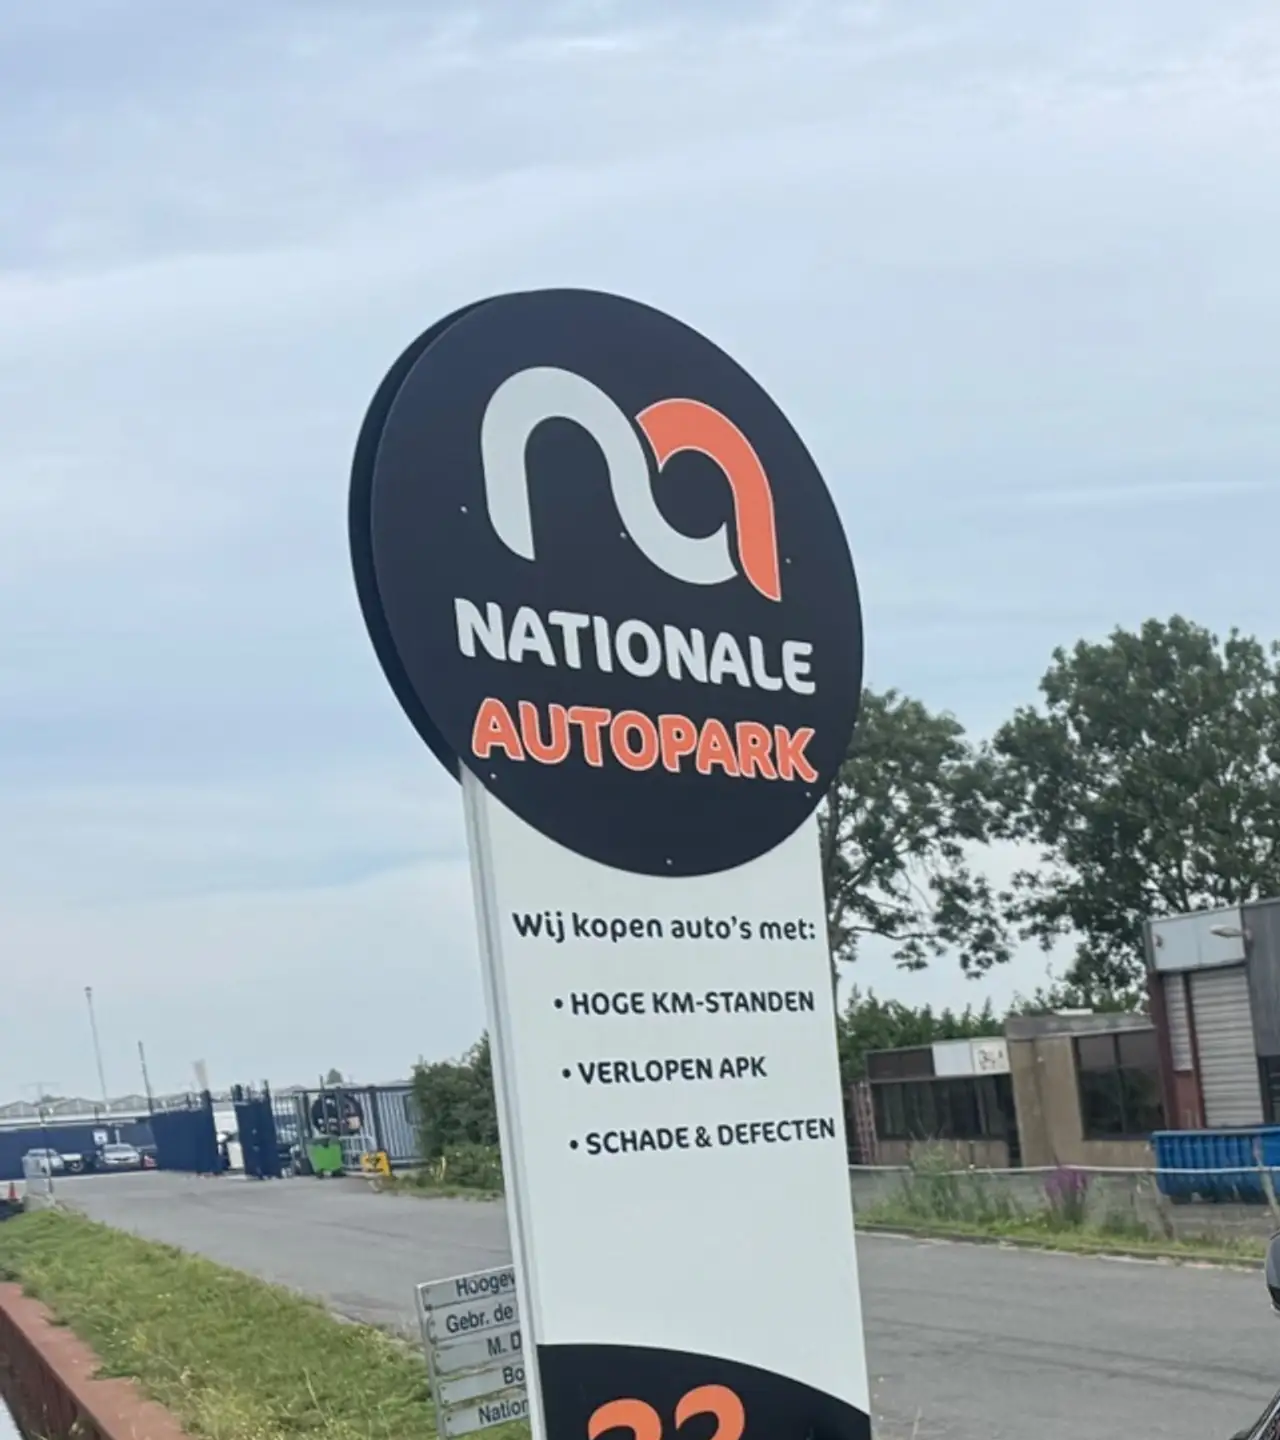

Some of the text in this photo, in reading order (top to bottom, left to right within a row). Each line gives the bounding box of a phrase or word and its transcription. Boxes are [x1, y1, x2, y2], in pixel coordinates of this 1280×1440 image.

[454, 597, 816, 694] NATIONALE
[472, 698, 818, 783] AUTOPARK
[511, 911, 816, 943] Wij kopen auto's met:
[571, 990, 815, 1015] HOGE KM-STANDEN
[577, 1056, 768, 1084] VERLOPEN APK
[585, 1117, 836, 1155] SCHADE & DEFECTEN
[446, 1304, 513, 1333] Gebr. de
